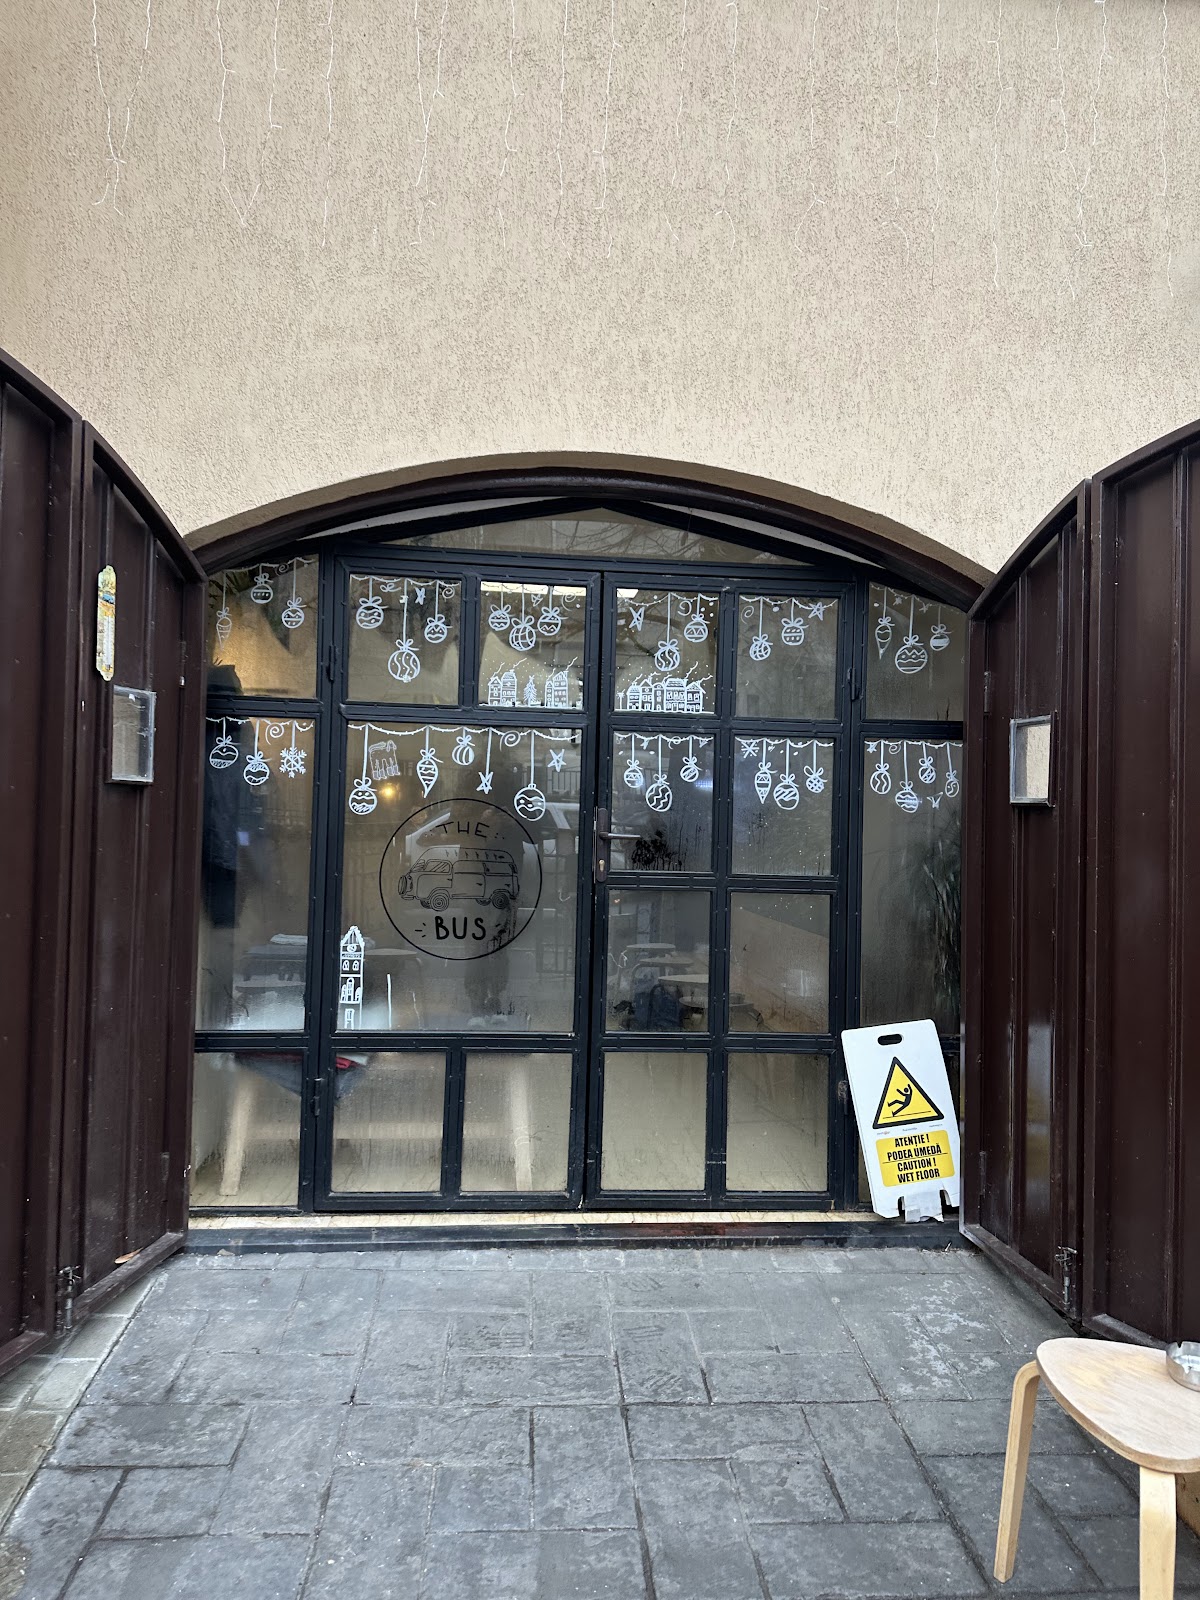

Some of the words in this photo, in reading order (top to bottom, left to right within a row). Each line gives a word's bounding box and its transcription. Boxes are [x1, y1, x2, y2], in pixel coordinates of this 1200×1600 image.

[435, 821, 490, 838] THE
[434, 915, 487, 941] BUS
[886, 1148, 913, 1161] PODEA
[914, 1143, 942, 1157] UMEDĂ
[897, 1158, 932, 1172] CAUTION
[897, 1172, 914, 1183] WET
[915, 1168, 940, 1181] FLOOR
